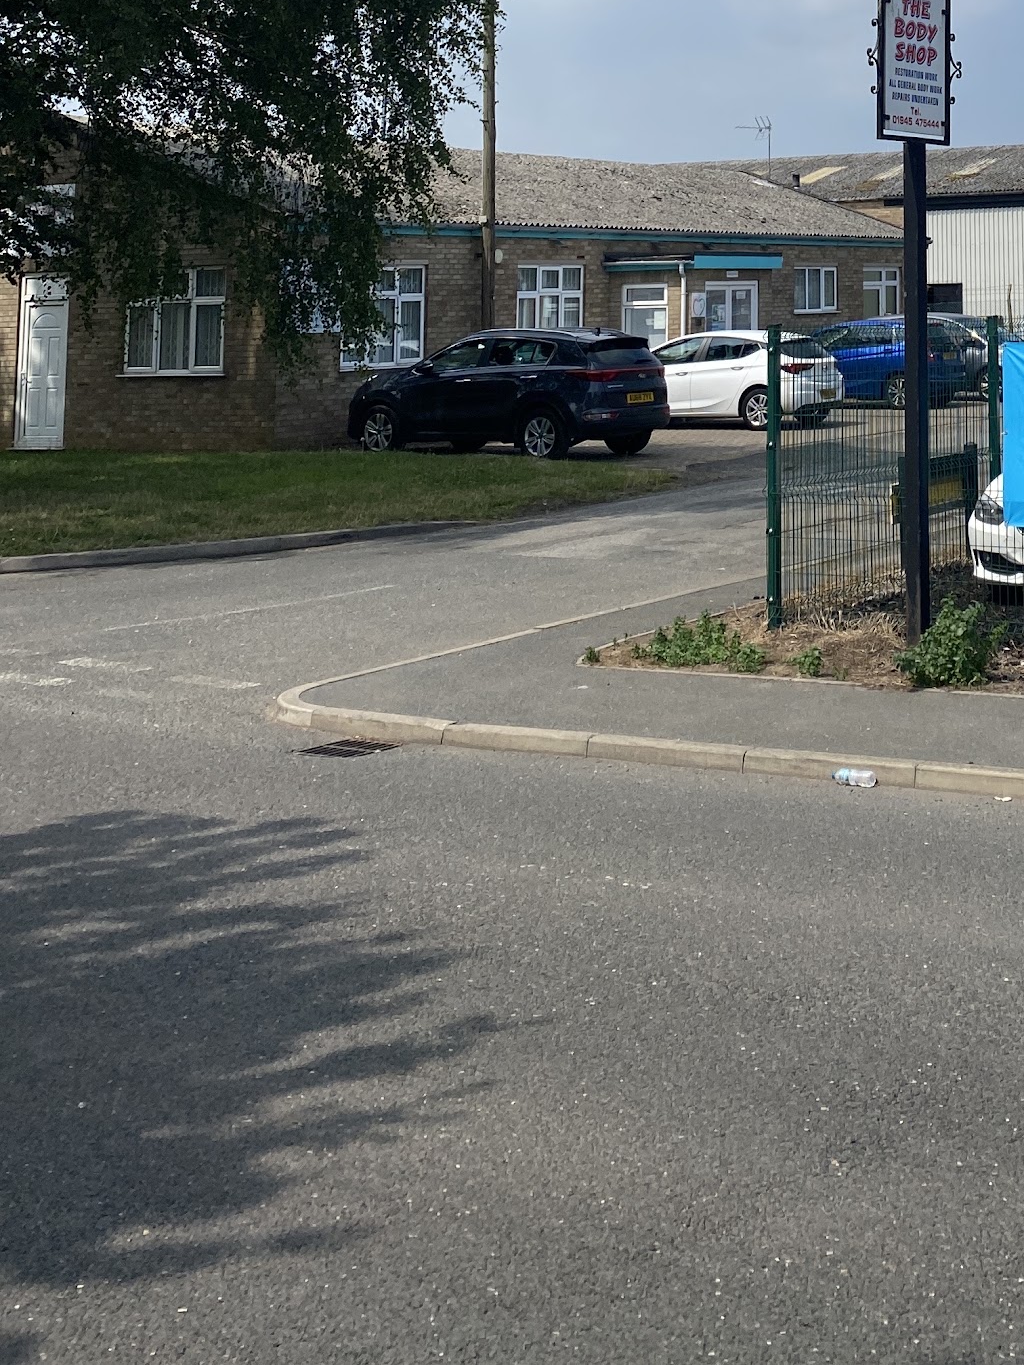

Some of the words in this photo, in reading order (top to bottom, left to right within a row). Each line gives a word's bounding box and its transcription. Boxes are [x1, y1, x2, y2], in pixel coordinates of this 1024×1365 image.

[894, 17, 938, 43] BODY
[895, 42, 937, 66] SHOP
[895, 67, 924, 80] RESTORATION
[925, 71, 938, 82] WORK
[889, 79, 897, 88] ALL
[897, 80, 917, 91] GENERAL
[917, 82, 929, 93] BODY
[929, 84, 943, 95] WORK
[892, 91, 911, 102] REPAIRS
[911, 94, 939, 107] UNDERTAKEN
[892, 115, 913, 125] 01945
[915, 118, 940, 129] 475444
